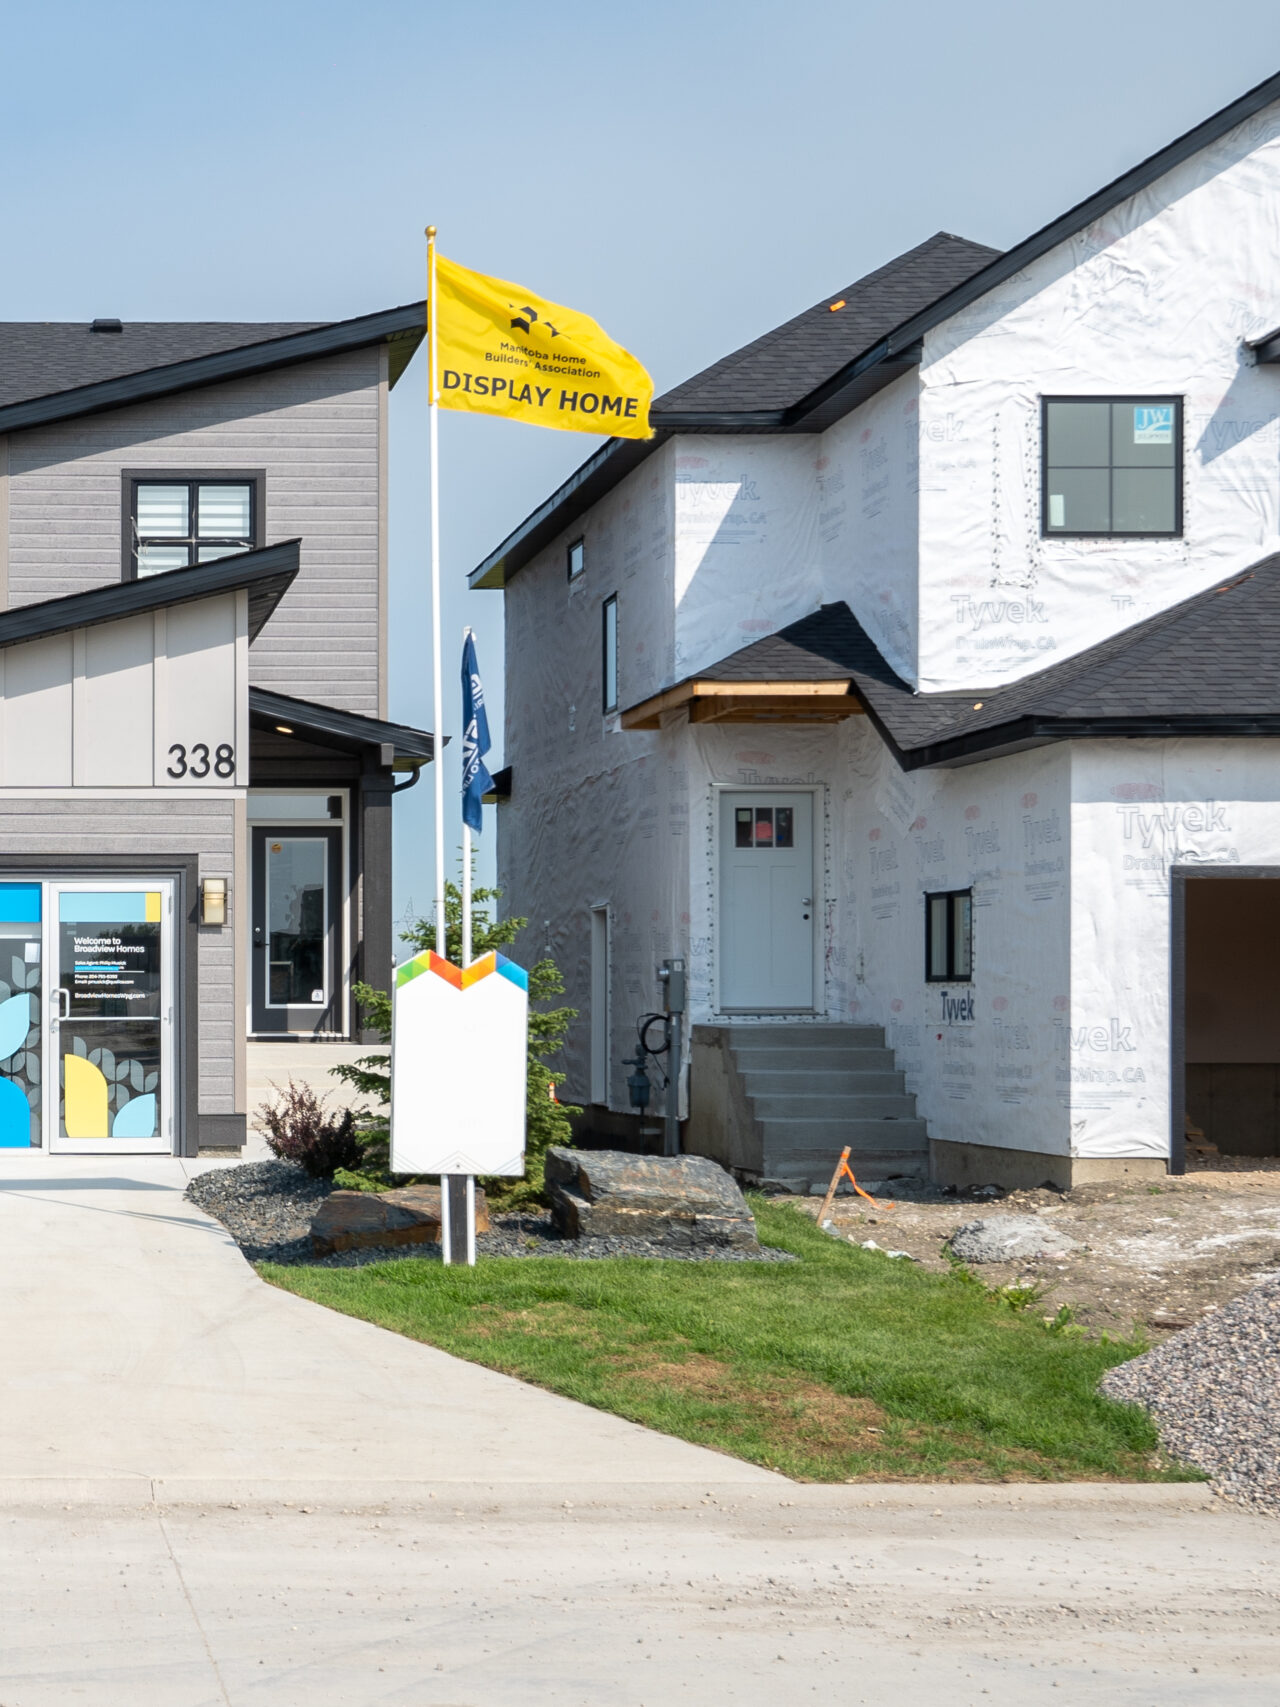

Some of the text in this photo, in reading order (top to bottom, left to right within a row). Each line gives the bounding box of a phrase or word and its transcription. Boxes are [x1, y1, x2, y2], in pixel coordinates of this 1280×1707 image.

[500, 342, 587, 365] Manitoba Home
[534, 361, 601, 379] Association
[442, 369, 639, 418] DISPLAY HOME
[167, 743, 235, 779] 338
[74, 937, 121, 945] Welcome to
[74, 945, 145, 953] Broadview Homes
[940, 990, 975, 1026] Tyvek
